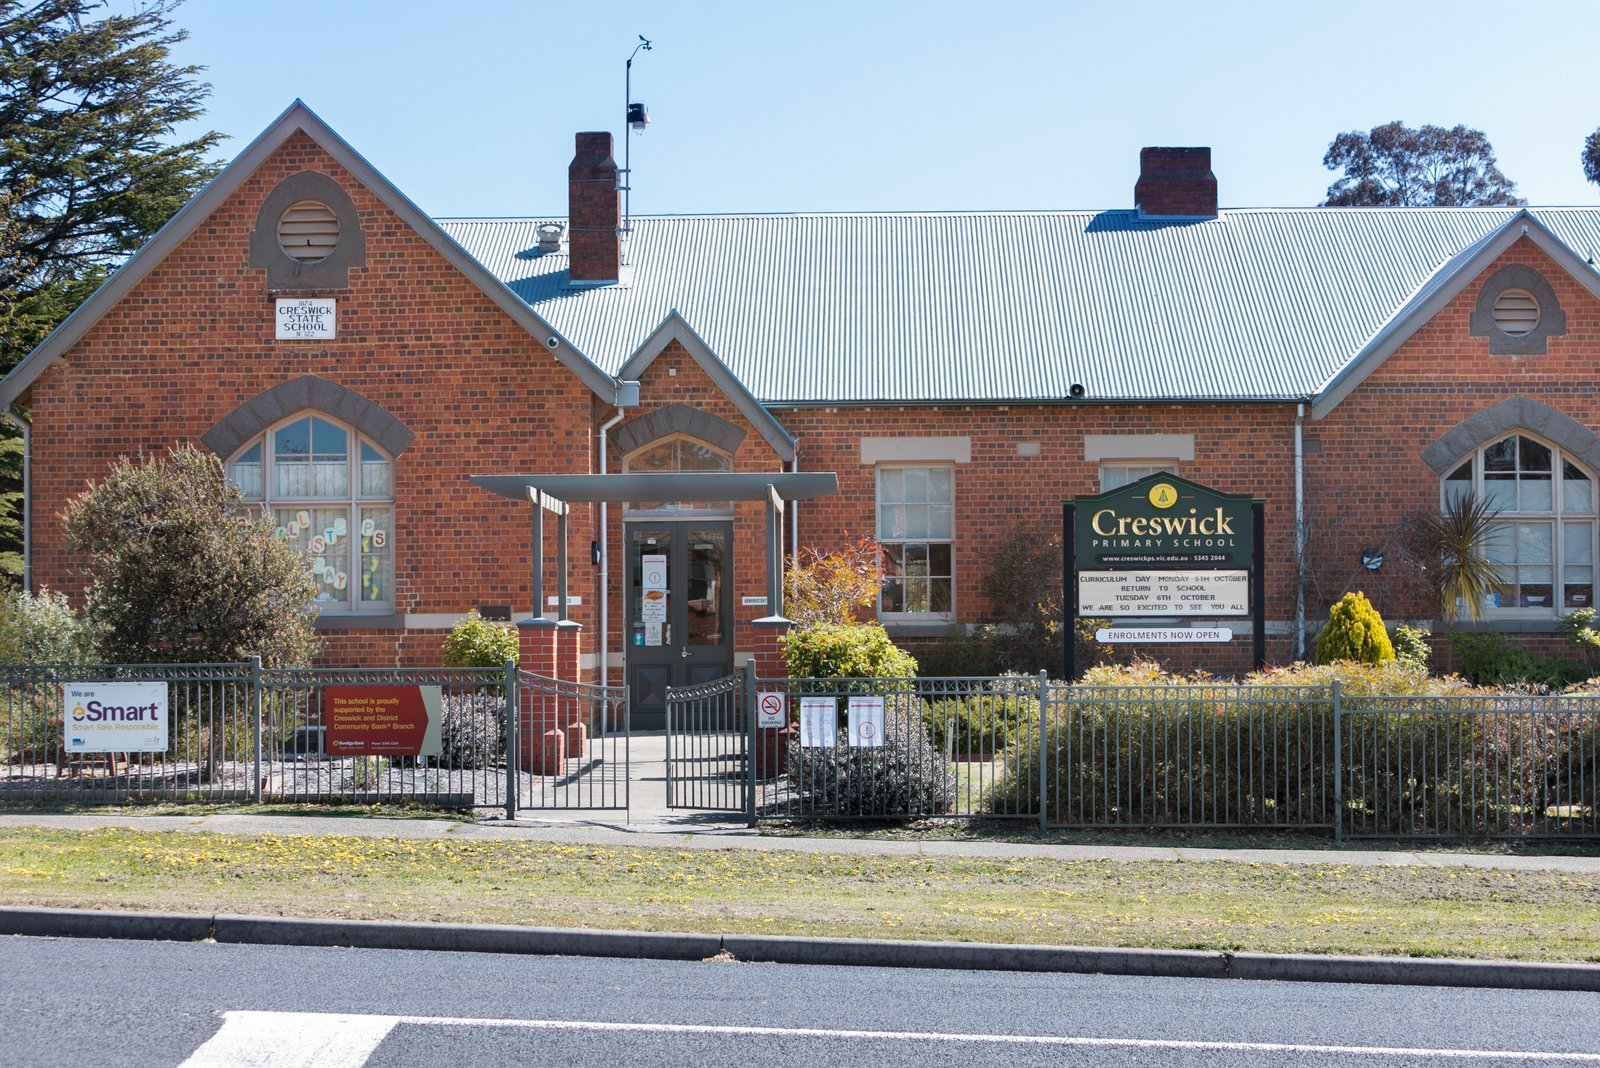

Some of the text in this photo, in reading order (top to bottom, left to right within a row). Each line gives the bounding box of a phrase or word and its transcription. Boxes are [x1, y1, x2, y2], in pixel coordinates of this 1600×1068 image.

[279, 306, 333, 315] CRESWICK
[289, 315, 322, 323] STATE
[284, 323, 328, 331] SCHOOL
[1092, 507, 1236, 536] Creswick
[1092, 539, 1236, 547] PRIMARY SCHOOL
[1102, 555, 1189, 563] www.creswickps.vic.edu.au
[1108, 631, 1220, 639] ENROLMENTS NOW OPEN
[377, 698, 399, 706] proudly
[334, 723, 369, 731] Community
